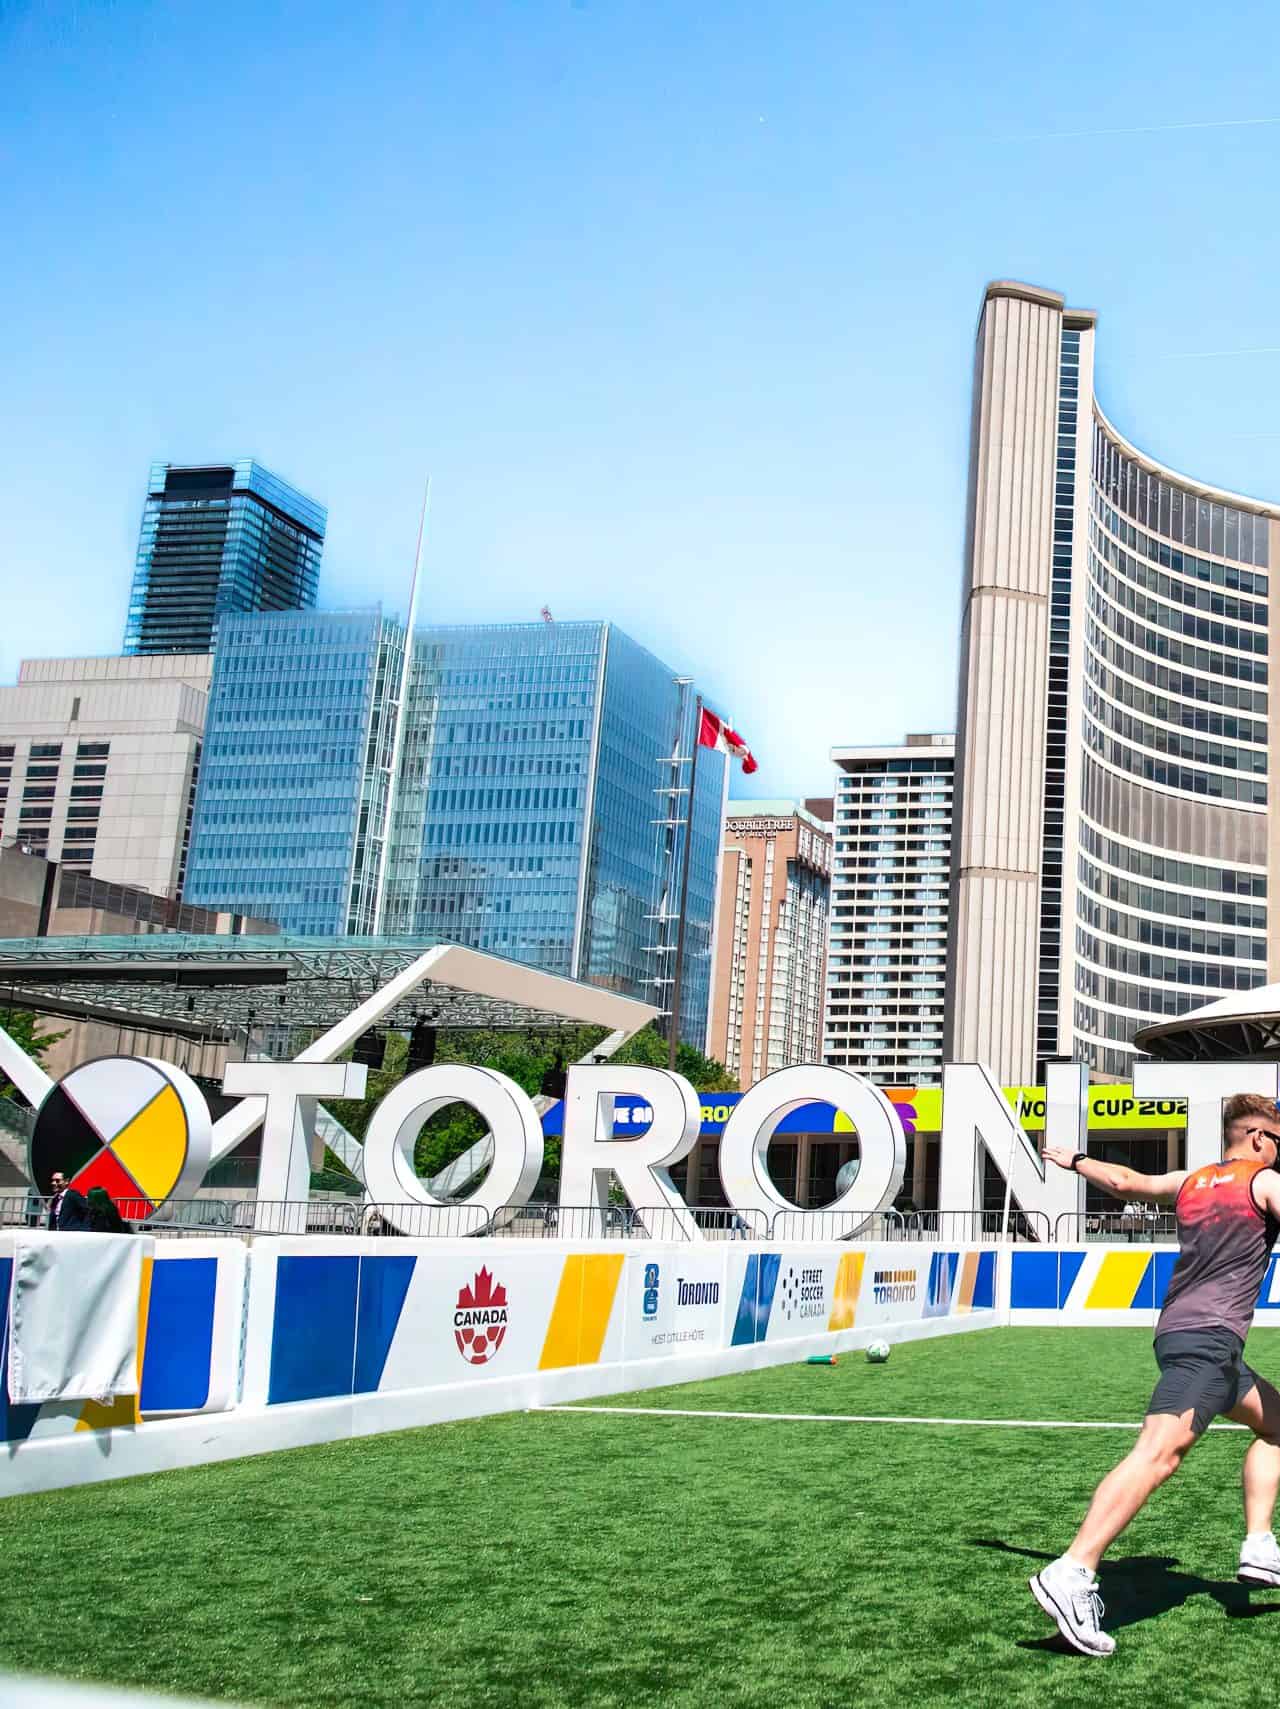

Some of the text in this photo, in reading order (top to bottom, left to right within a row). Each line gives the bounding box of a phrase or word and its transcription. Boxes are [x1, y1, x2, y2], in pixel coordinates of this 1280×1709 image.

[1092, 1099, 1188, 1117] CUP 202
[800, 1269, 823, 1284] STREET
[676, 1278, 720, 1306] TORONTO
[800, 1285, 824, 1302] SOCCER
[873, 1285, 917, 1305] TORONTO
[453, 1309, 508, 1327] CANADA
[800, 1303, 825, 1319] CANADA
